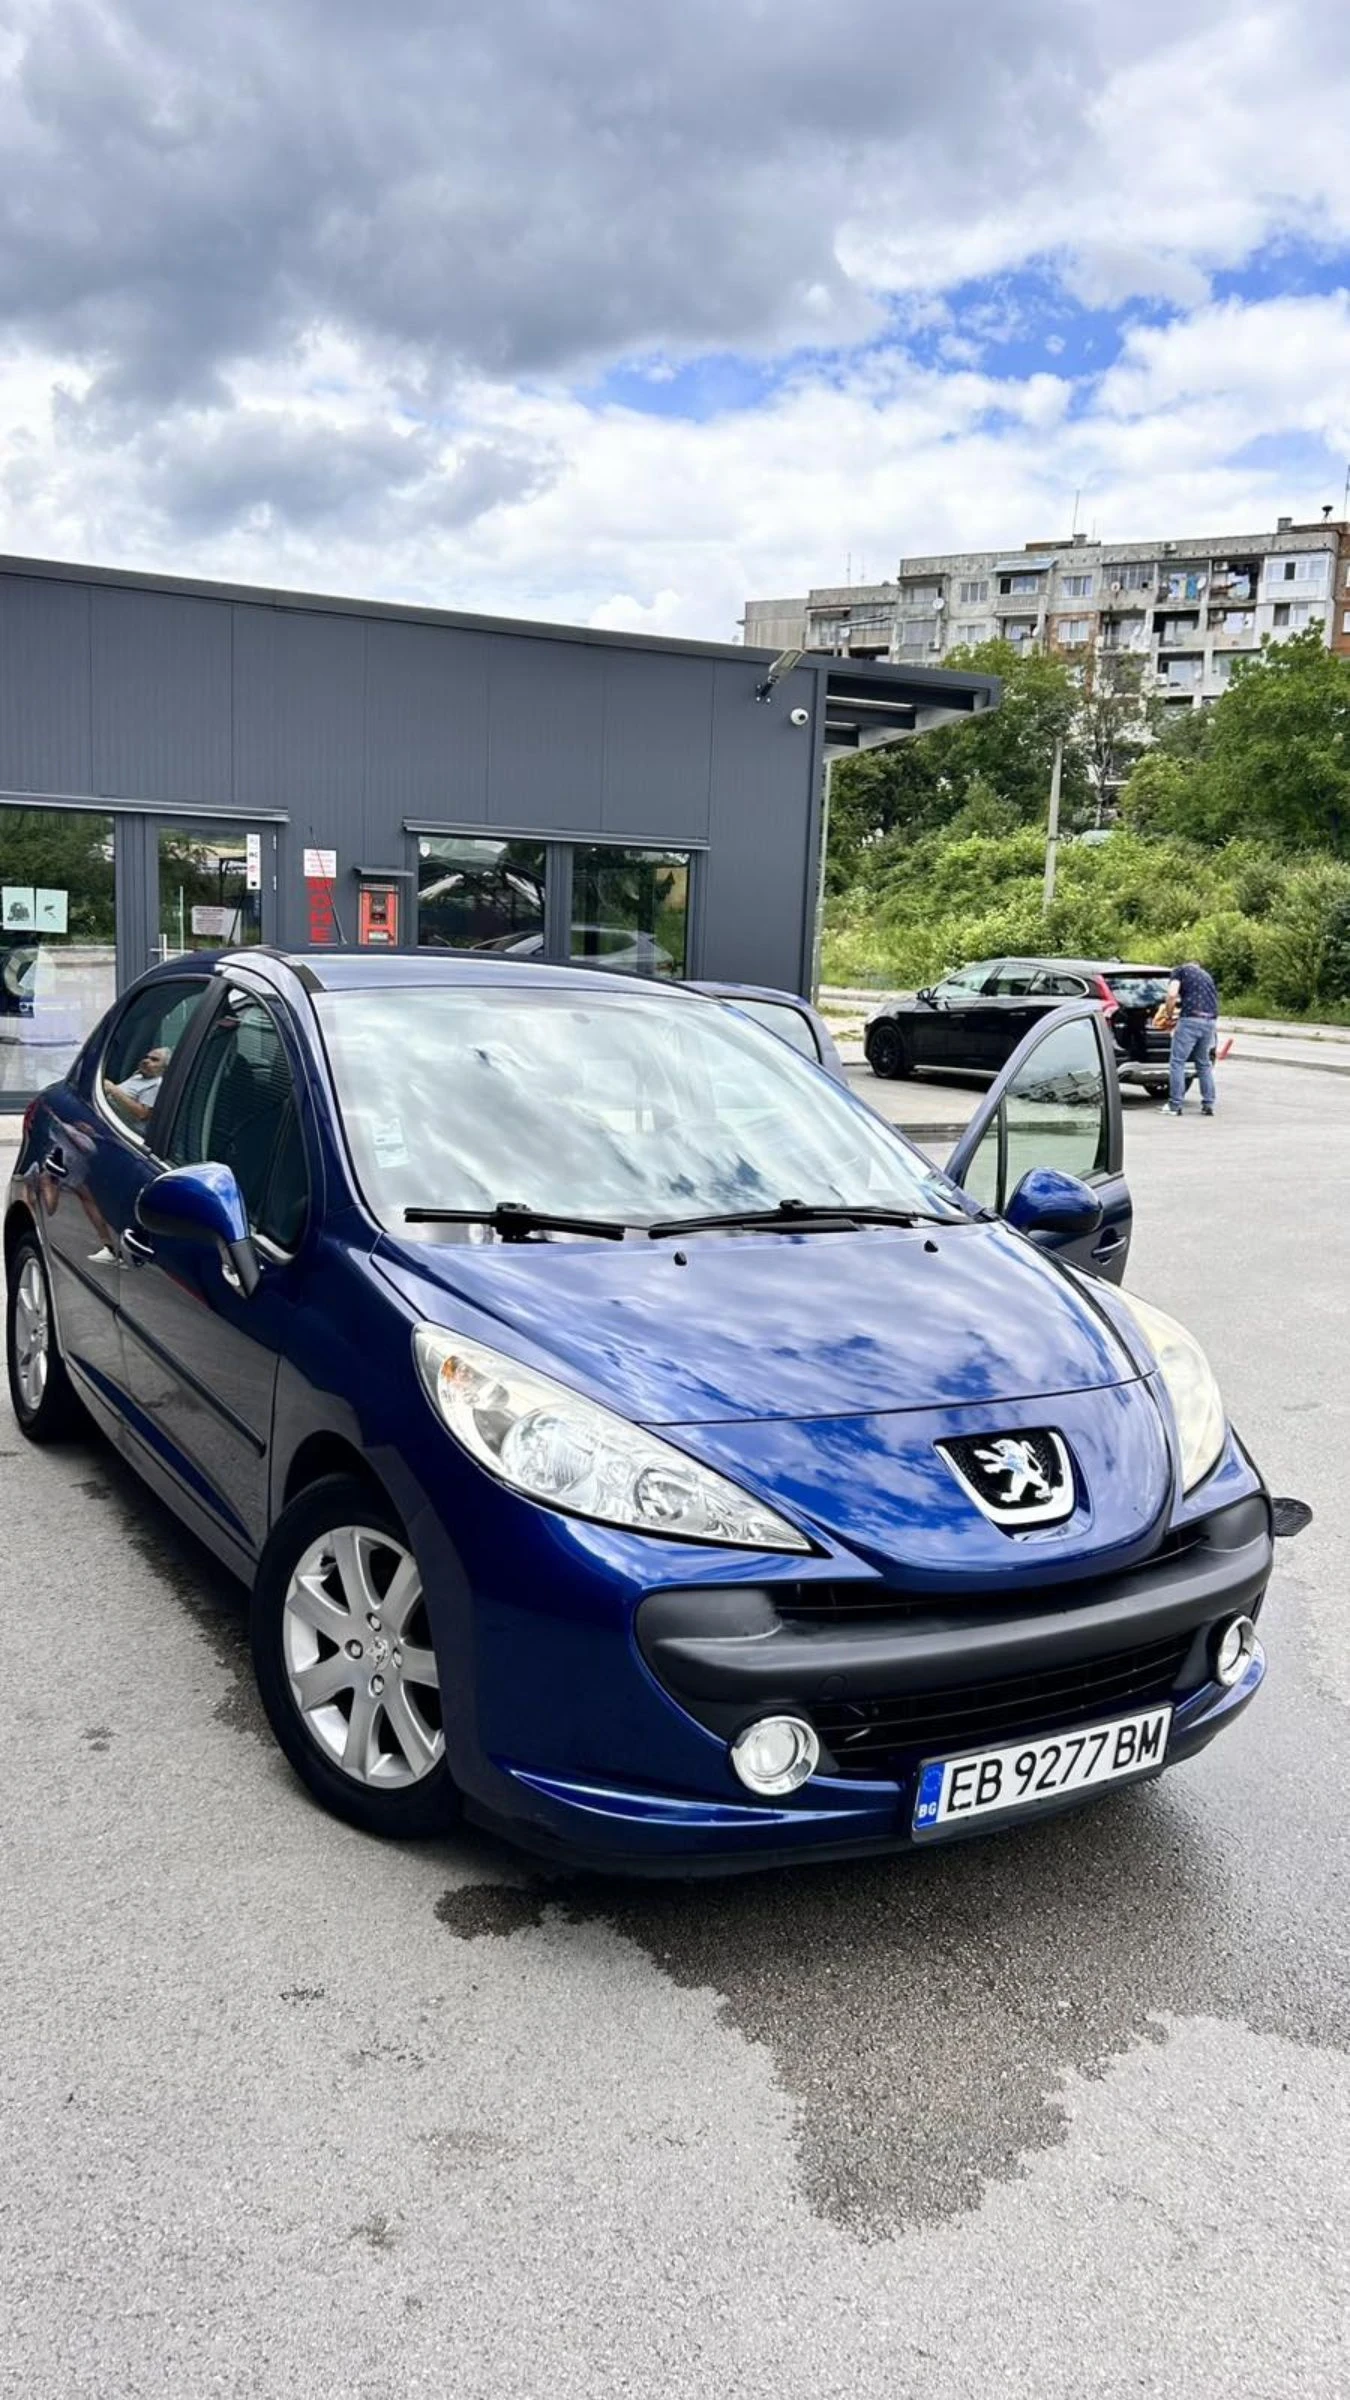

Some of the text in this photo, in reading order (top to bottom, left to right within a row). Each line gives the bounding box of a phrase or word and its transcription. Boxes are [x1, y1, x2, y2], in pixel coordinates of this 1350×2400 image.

[946, 1716, 1164, 1813] EB 9277 BM
[918, 1802, 937, 1818] BG
